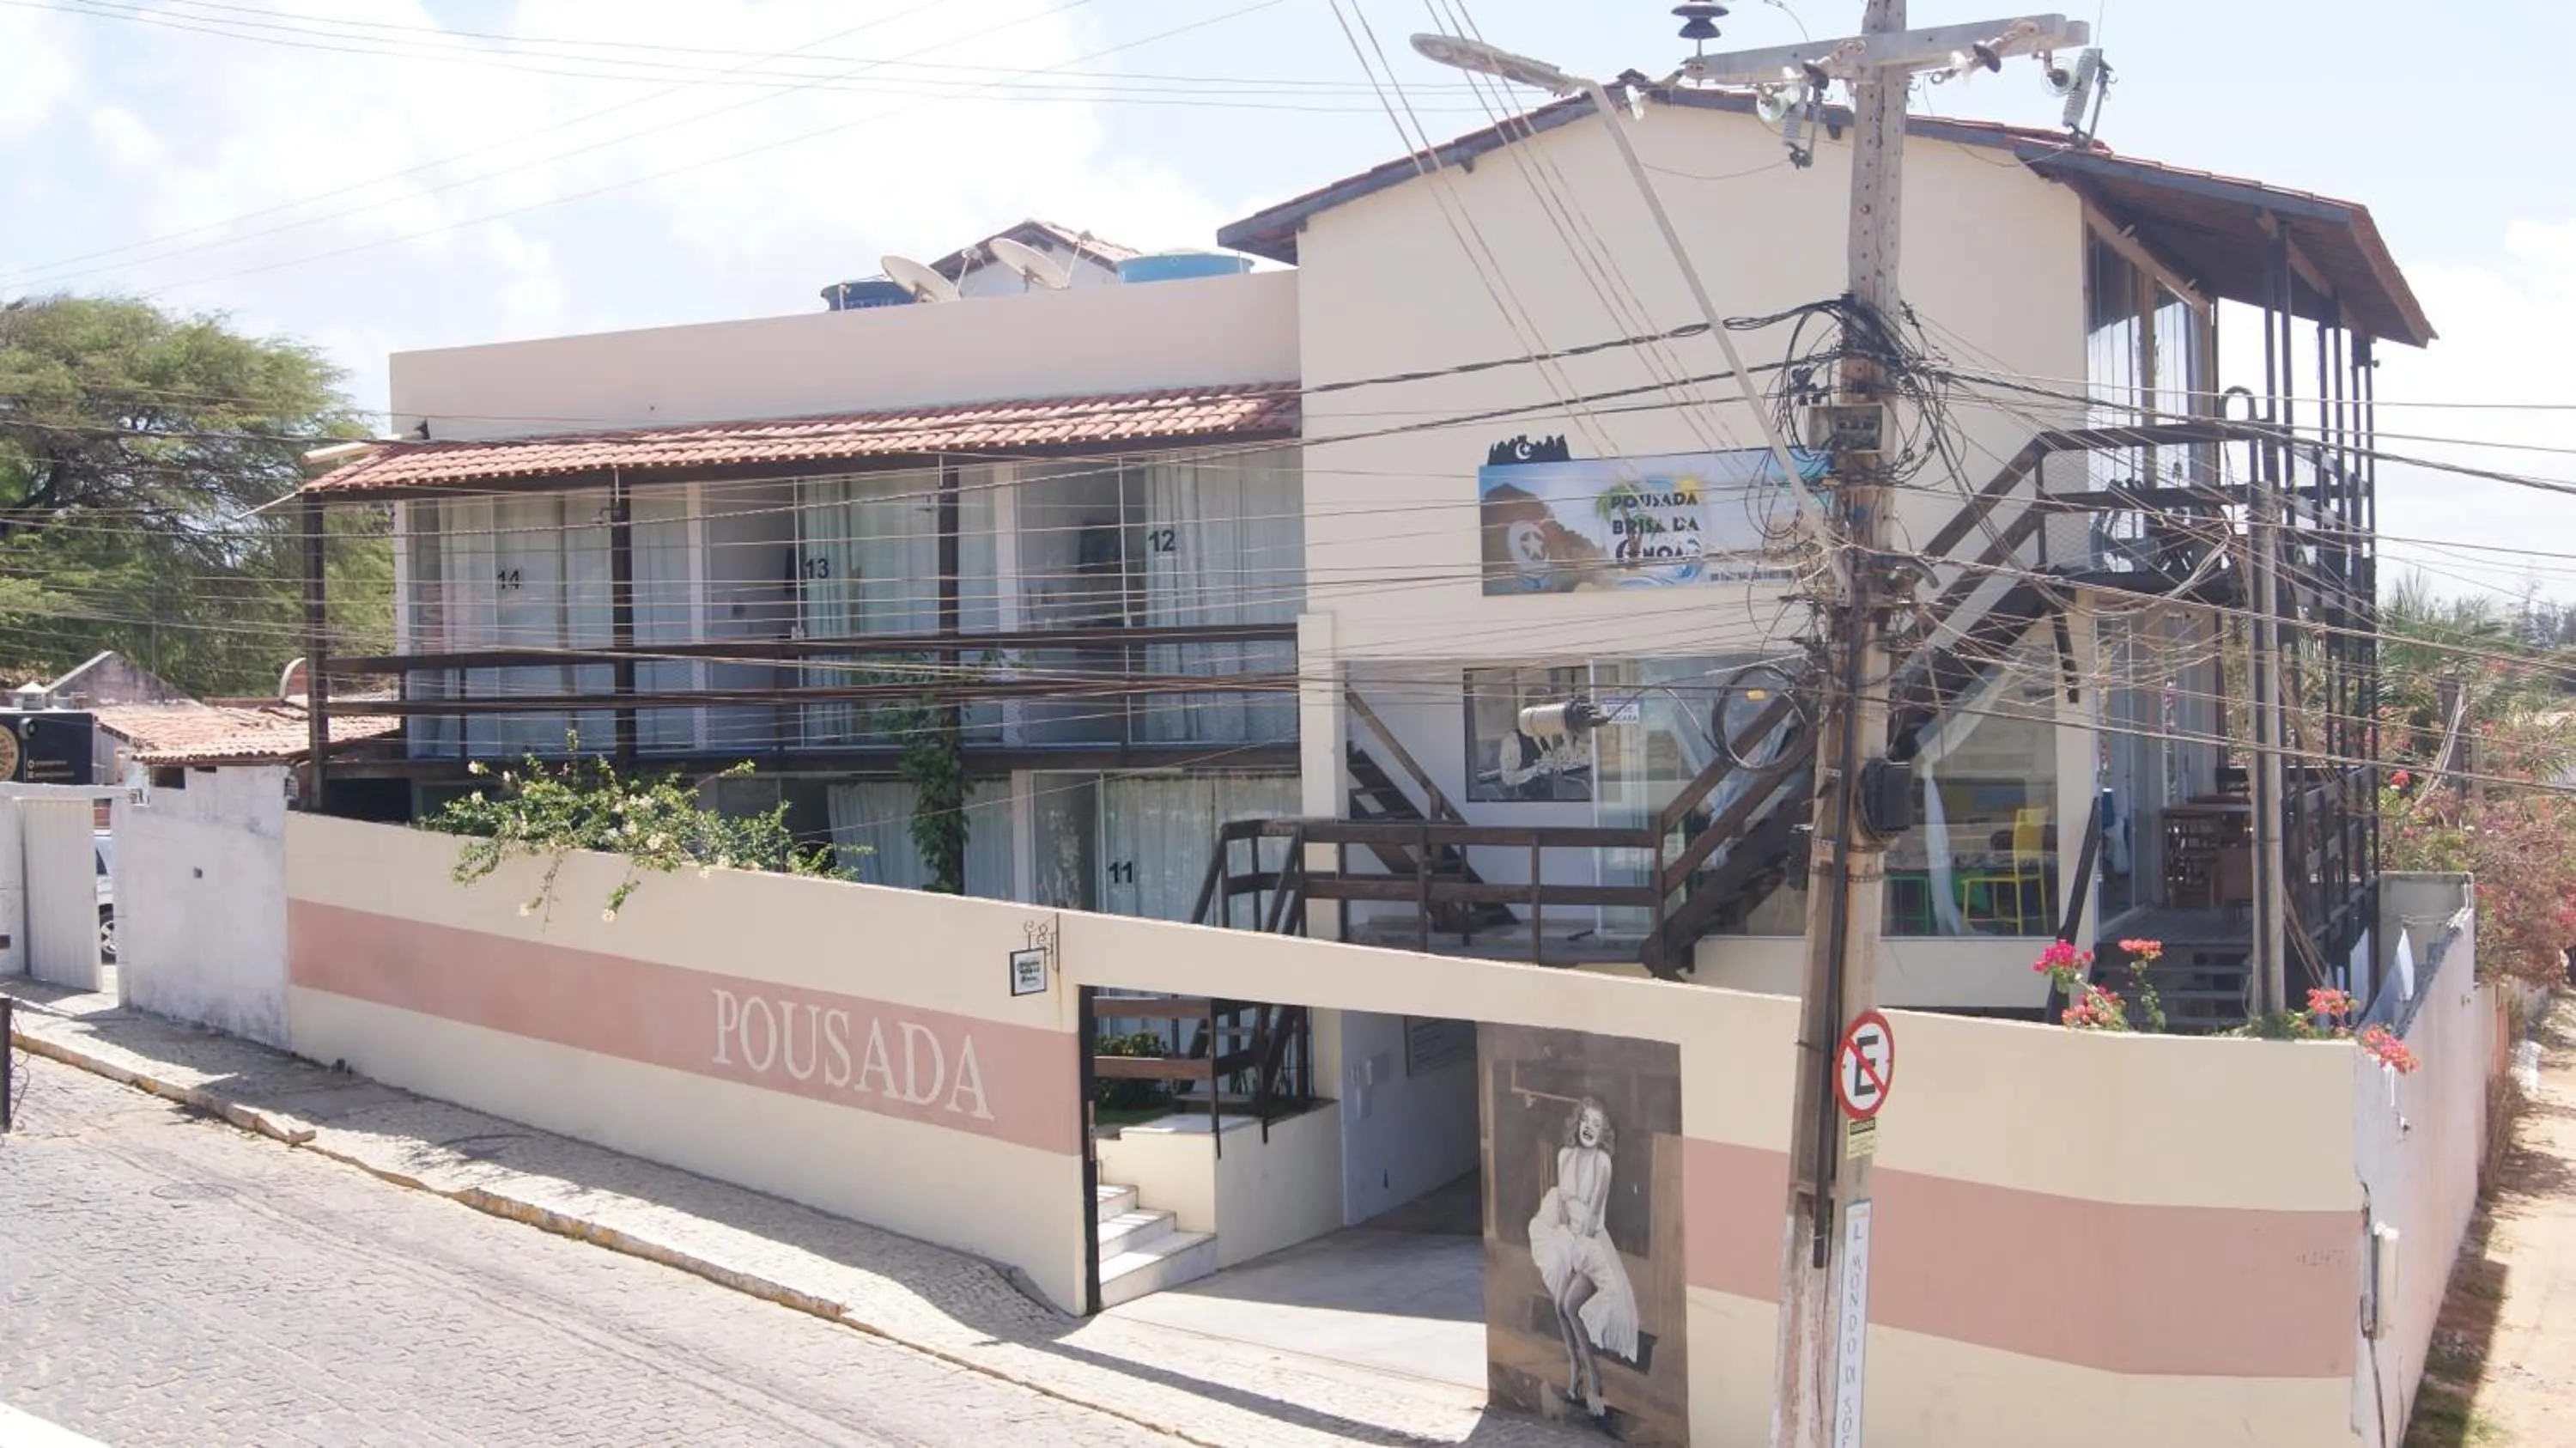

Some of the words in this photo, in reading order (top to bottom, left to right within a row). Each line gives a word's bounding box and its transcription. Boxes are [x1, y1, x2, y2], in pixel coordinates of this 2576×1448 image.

[1611, 492, 1698, 508] POUSADA
[1673, 516, 1701, 532] DA
[1148, 530, 1176, 551] 12
[805, 558, 829, 579] 13
[497, 569, 521, 590] 14
[1109, 861, 1133, 884] 11
[711, 989, 996, 1122] POUSADA
[1854, 1035, 1879, 1096] E
